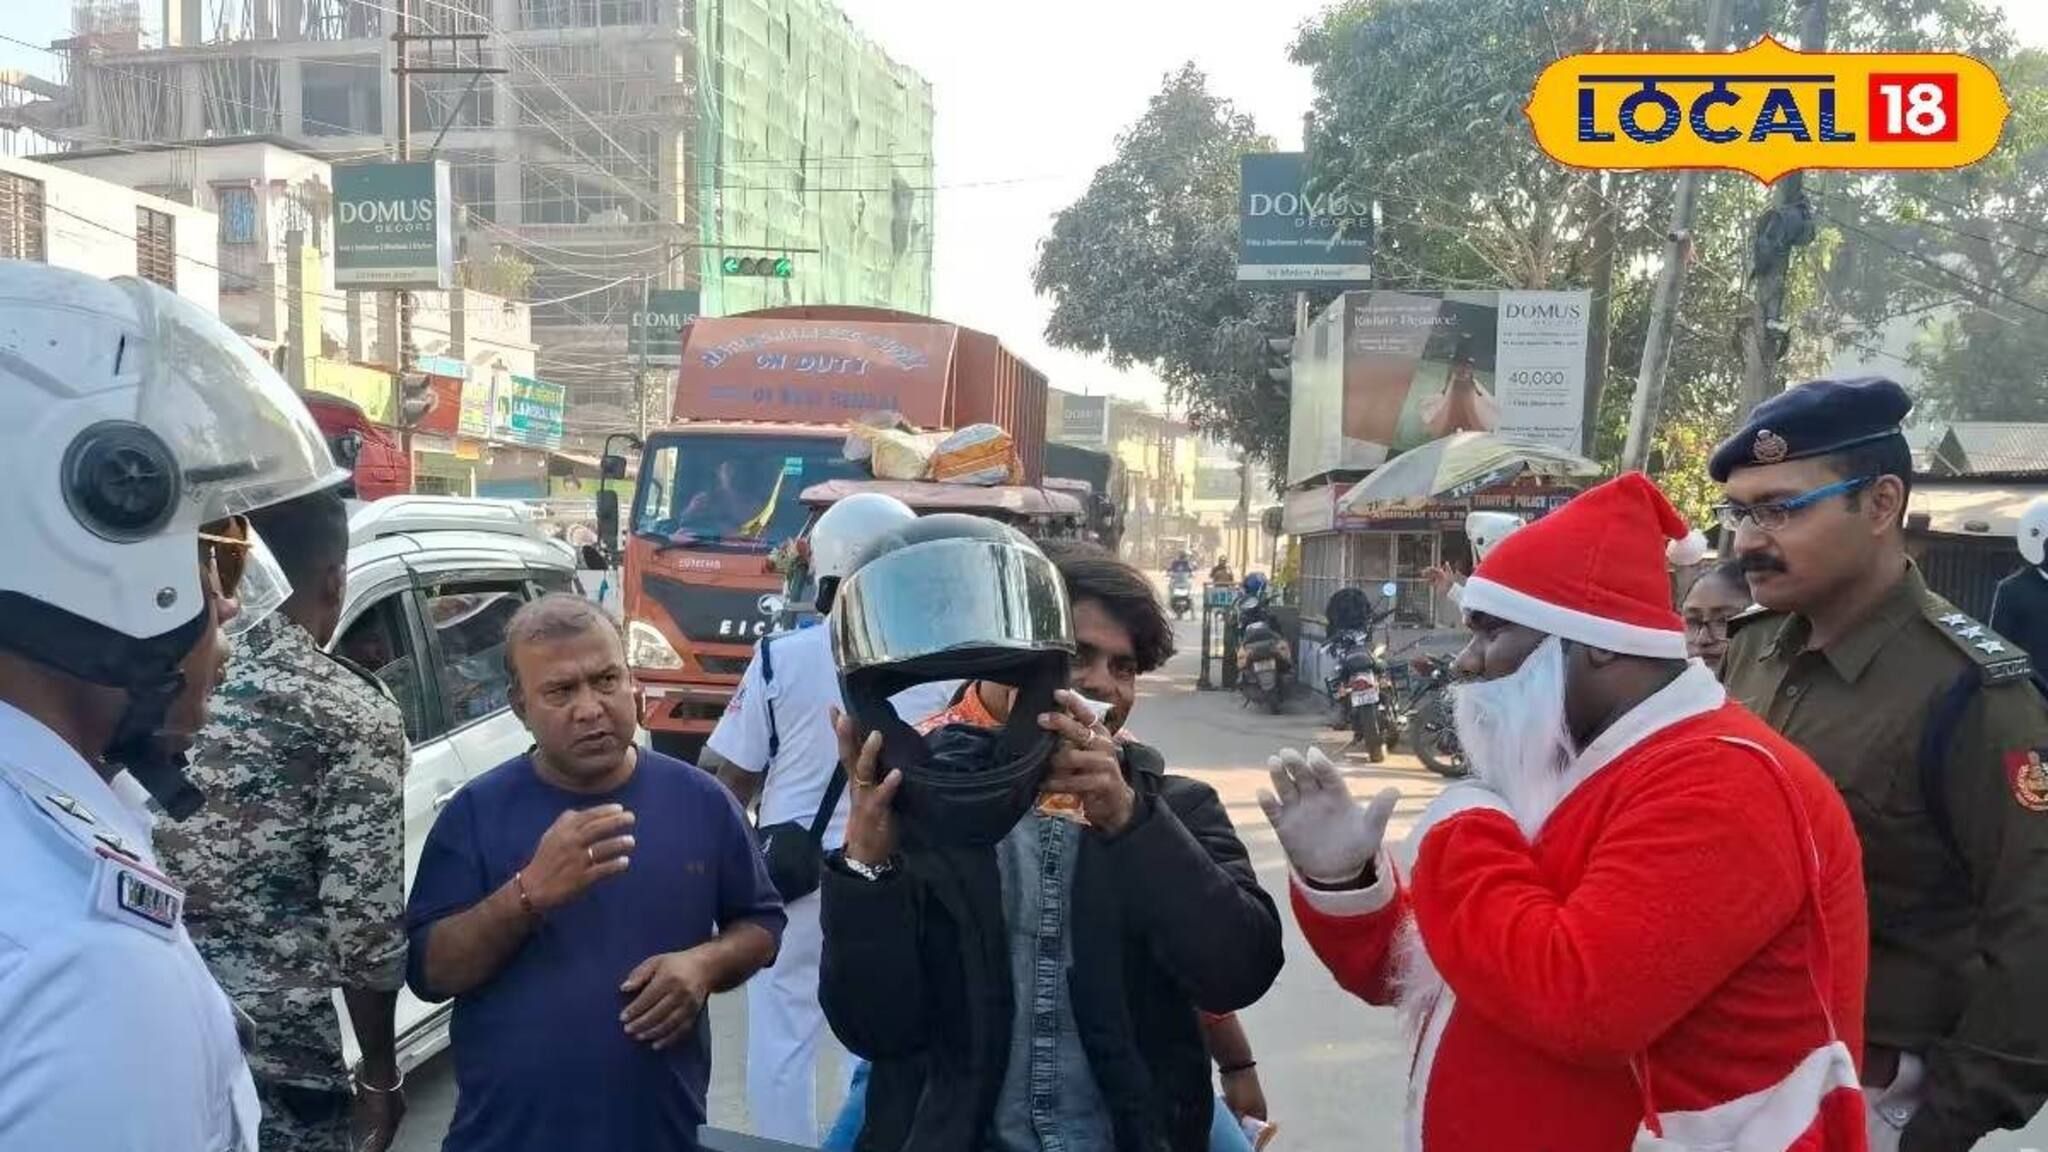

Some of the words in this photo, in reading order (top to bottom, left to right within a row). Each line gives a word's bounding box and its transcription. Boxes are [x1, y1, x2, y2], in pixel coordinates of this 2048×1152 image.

[339, 198, 433, 223] DOMUS
[1506, 303, 1580, 319] DOMUS
[1508, 371, 1564, 386] 40,000
